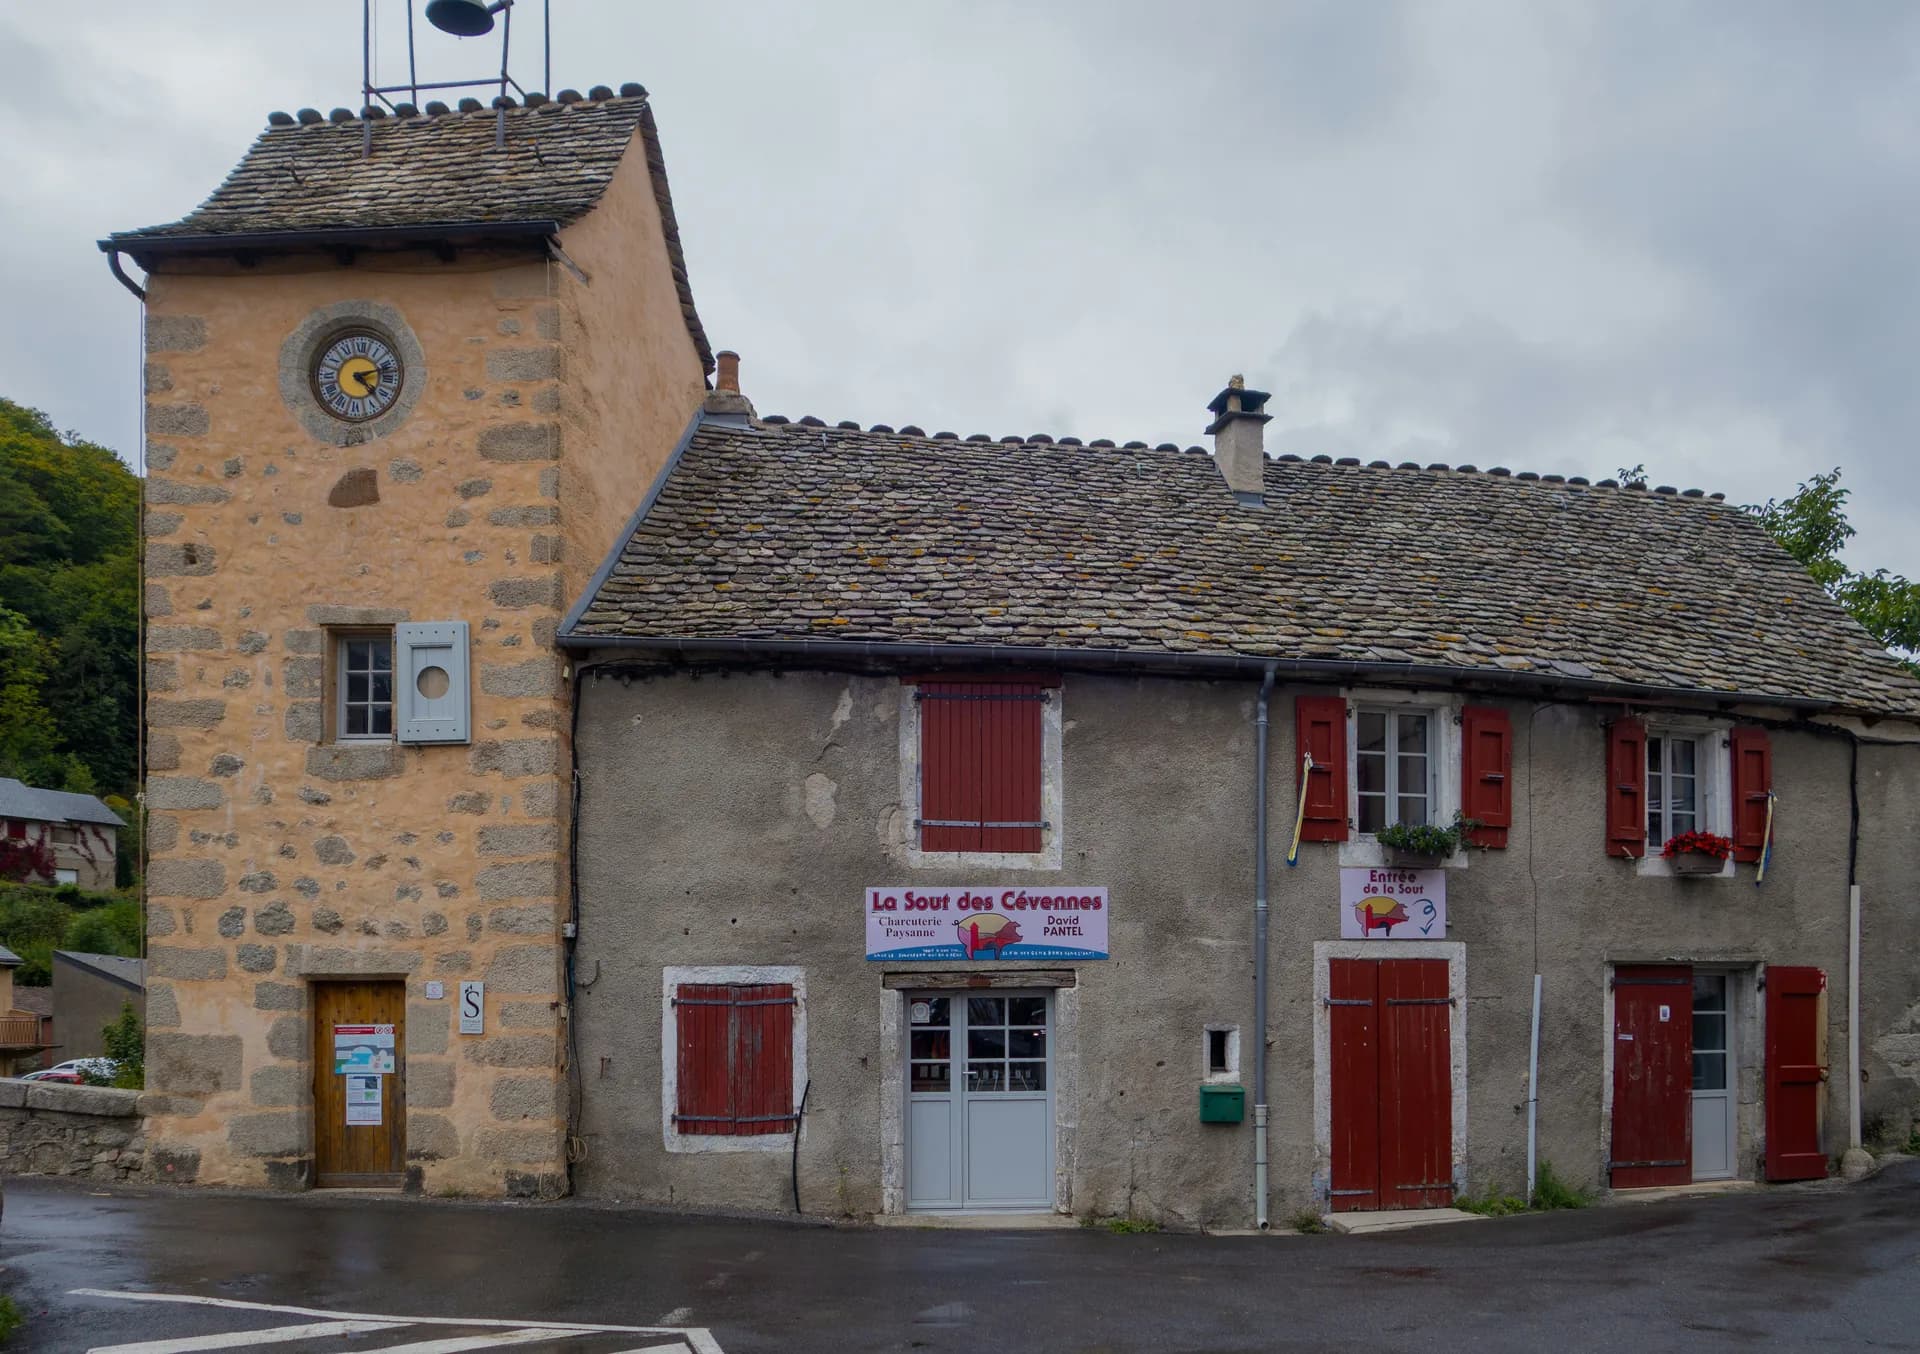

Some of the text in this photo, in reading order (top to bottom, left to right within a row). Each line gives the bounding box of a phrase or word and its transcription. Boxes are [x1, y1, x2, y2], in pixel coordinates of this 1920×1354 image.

[1370, 870, 1417, 883] Entrée
[1363, 884, 1425, 895] de la Sout
[872, 890, 1103, 911] La Sout des Cévennes
[879, 916, 942, 927] Charcuterie
[1047, 916, 1079, 925] David
[885, 927, 936, 939] Paysanne
[1043, 926, 1083, 937] PANTEL
[464, 990, 480, 1018] S
